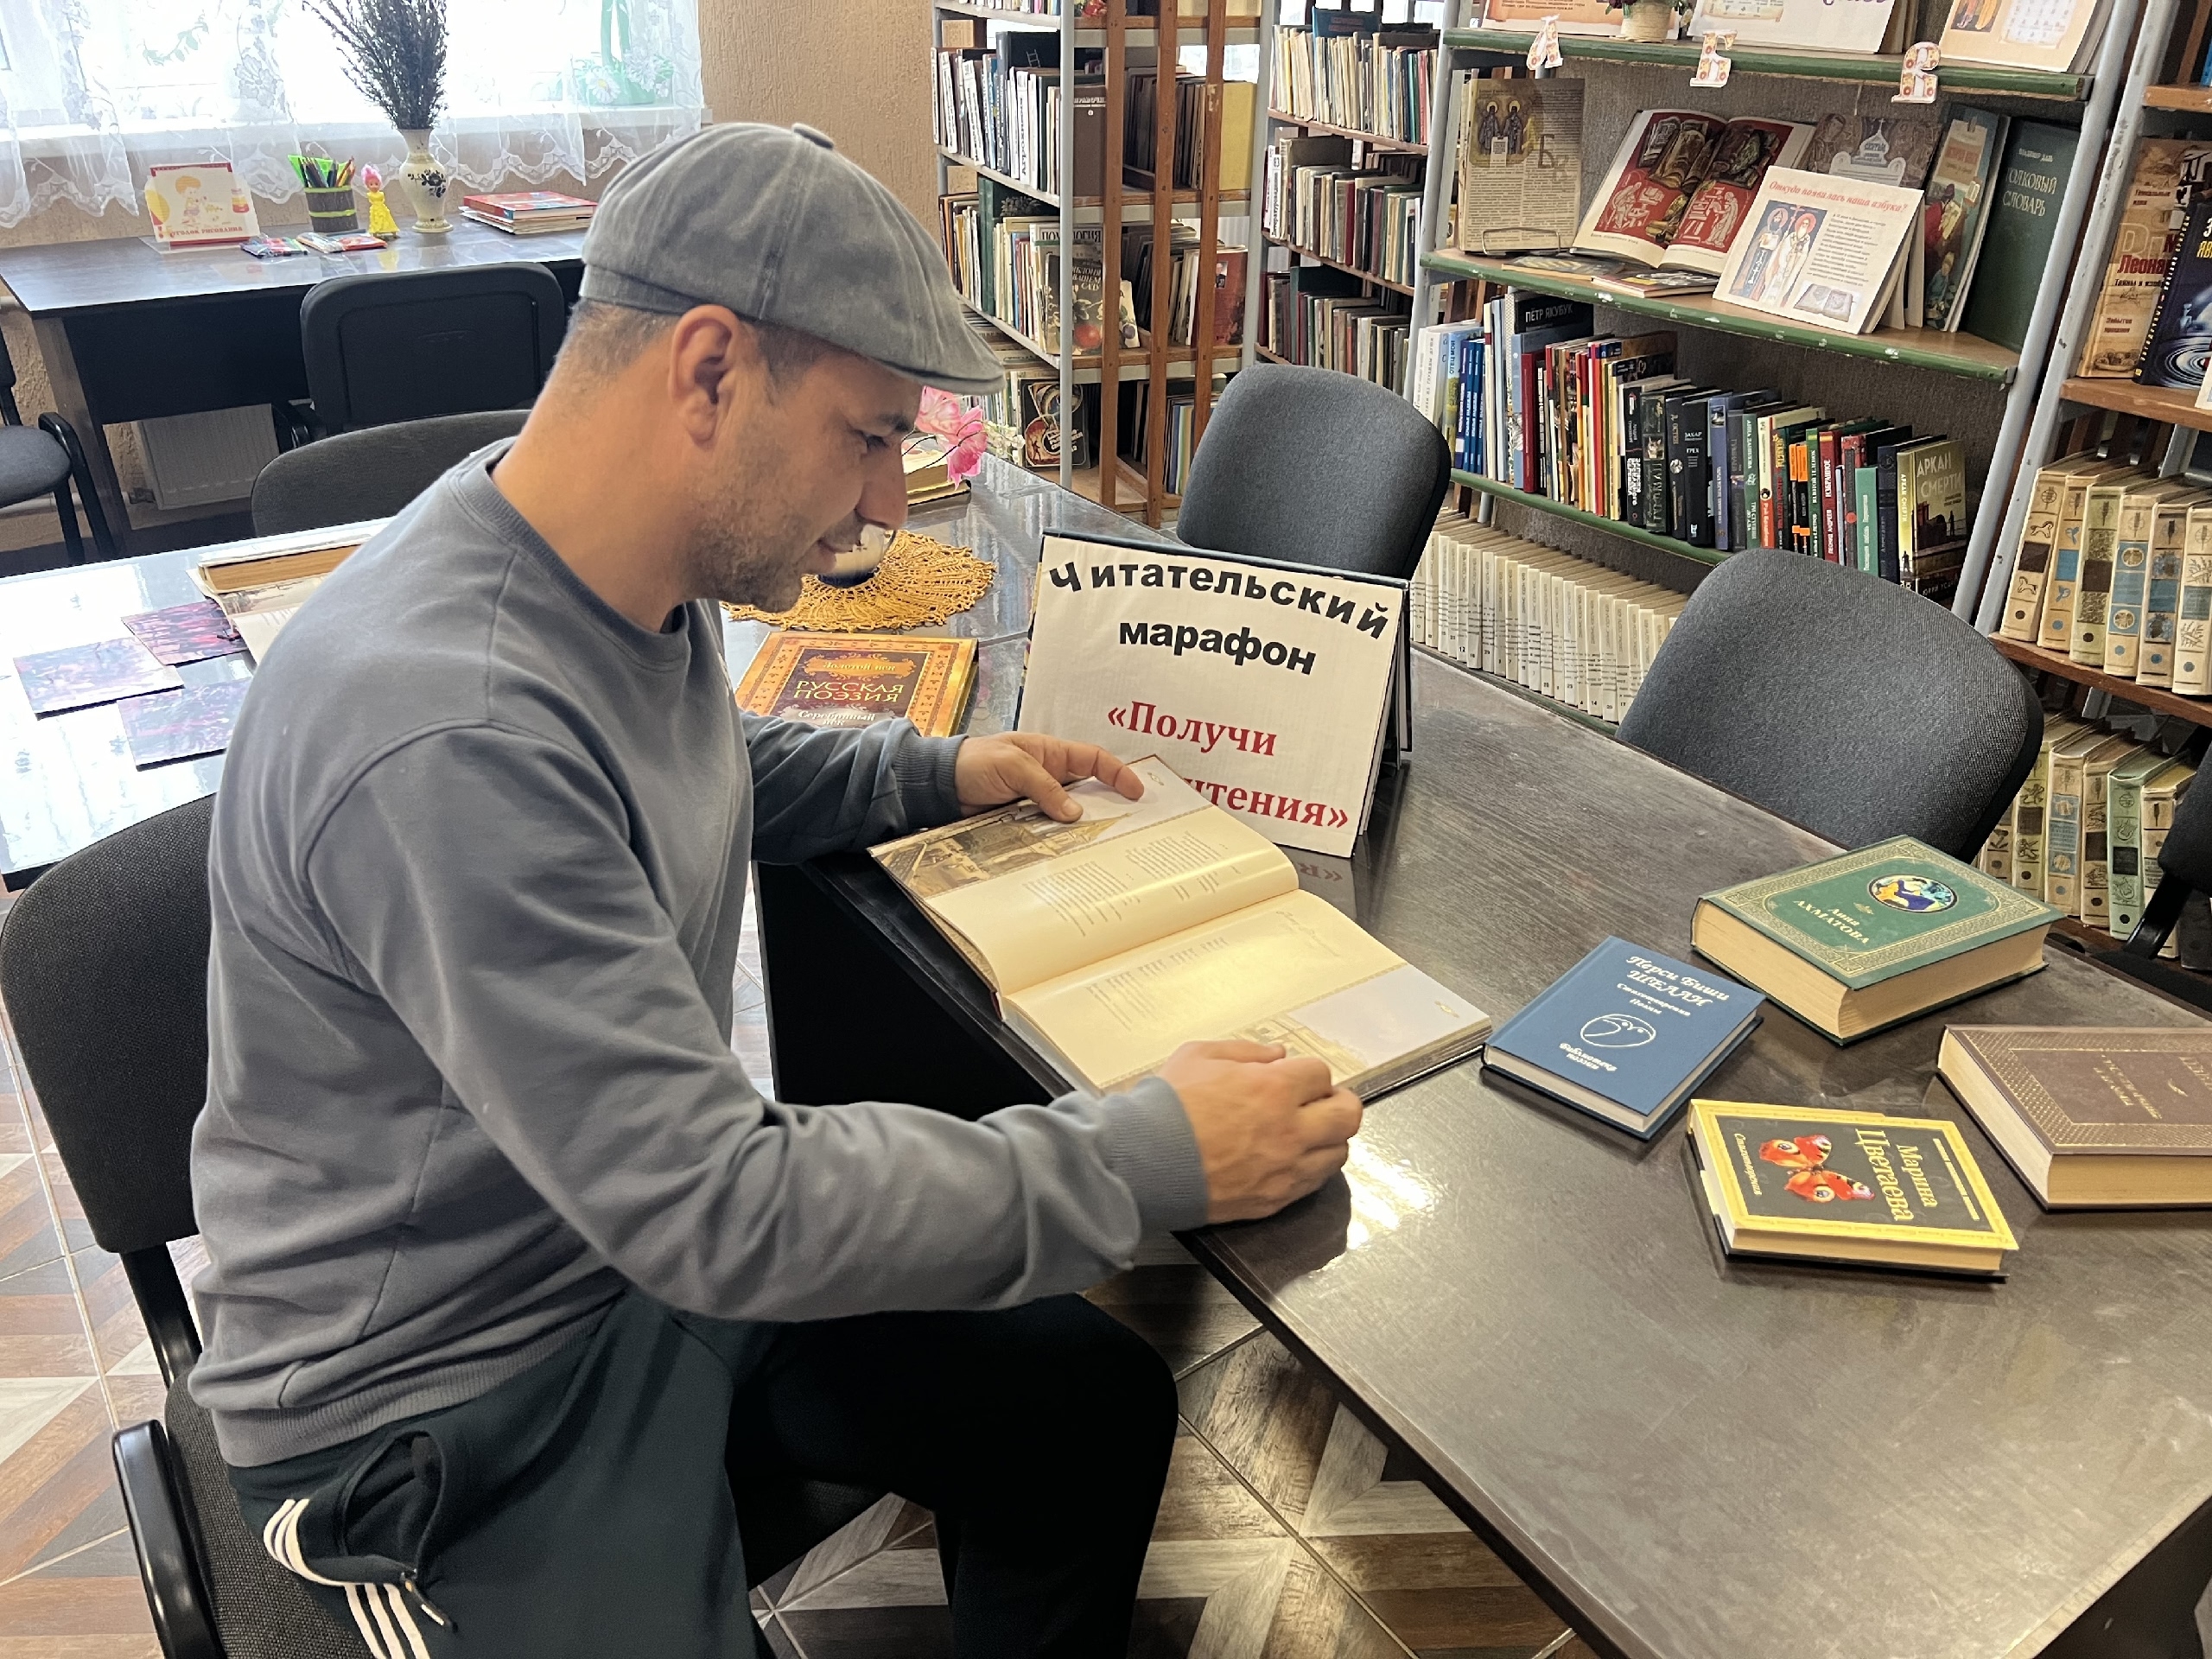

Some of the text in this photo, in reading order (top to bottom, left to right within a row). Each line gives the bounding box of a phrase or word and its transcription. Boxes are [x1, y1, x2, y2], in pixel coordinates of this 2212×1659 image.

[1769, 181, 1908, 213] Откуда появилась наша азбука?
[2005, 167, 2057, 195] ТОЛКОВЫЙ
[2002, 190, 2046, 217] СЛОВАРЬ
[201, 226, 243, 234] РИСОВАНИЯ
[1525, 303, 1573, 323] ПЁТР ЯКУБУК
[1823, 459, 1832, 498] ИЗБРАННОЕ
[1916, 450, 1952, 478] АРКАН
[1920, 472, 1962, 498] СМЕРТИ
[1049, 561, 1389, 640] Читательский
[1119, 621, 1317, 676] марафон
[822, 661, 896, 672] Золотой век
[793, 690, 899, 702] ПОЭЗИЯ
[795, 680, 906, 694] РУССКАЯ
[798, 709, 876, 722] Серебряный
[1107, 700, 1277, 757] «Получи
[1792, 900, 1870, 944] АХМАТОВА
[1625, 956, 1730, 1001] Перси Биши
[1626, 969, 1713, 1007] ШЕЛЛИ
[1617, 982, 1692, 1017] Стихотворения
[1559, 1042, 1618, 1072] Библиотека
[1733, 1132, 1763, 1197] Стихотворения
[1854, 1127, 1915, 1222] Цветаева
[1896, 1143, 1938, 1208] Марина
